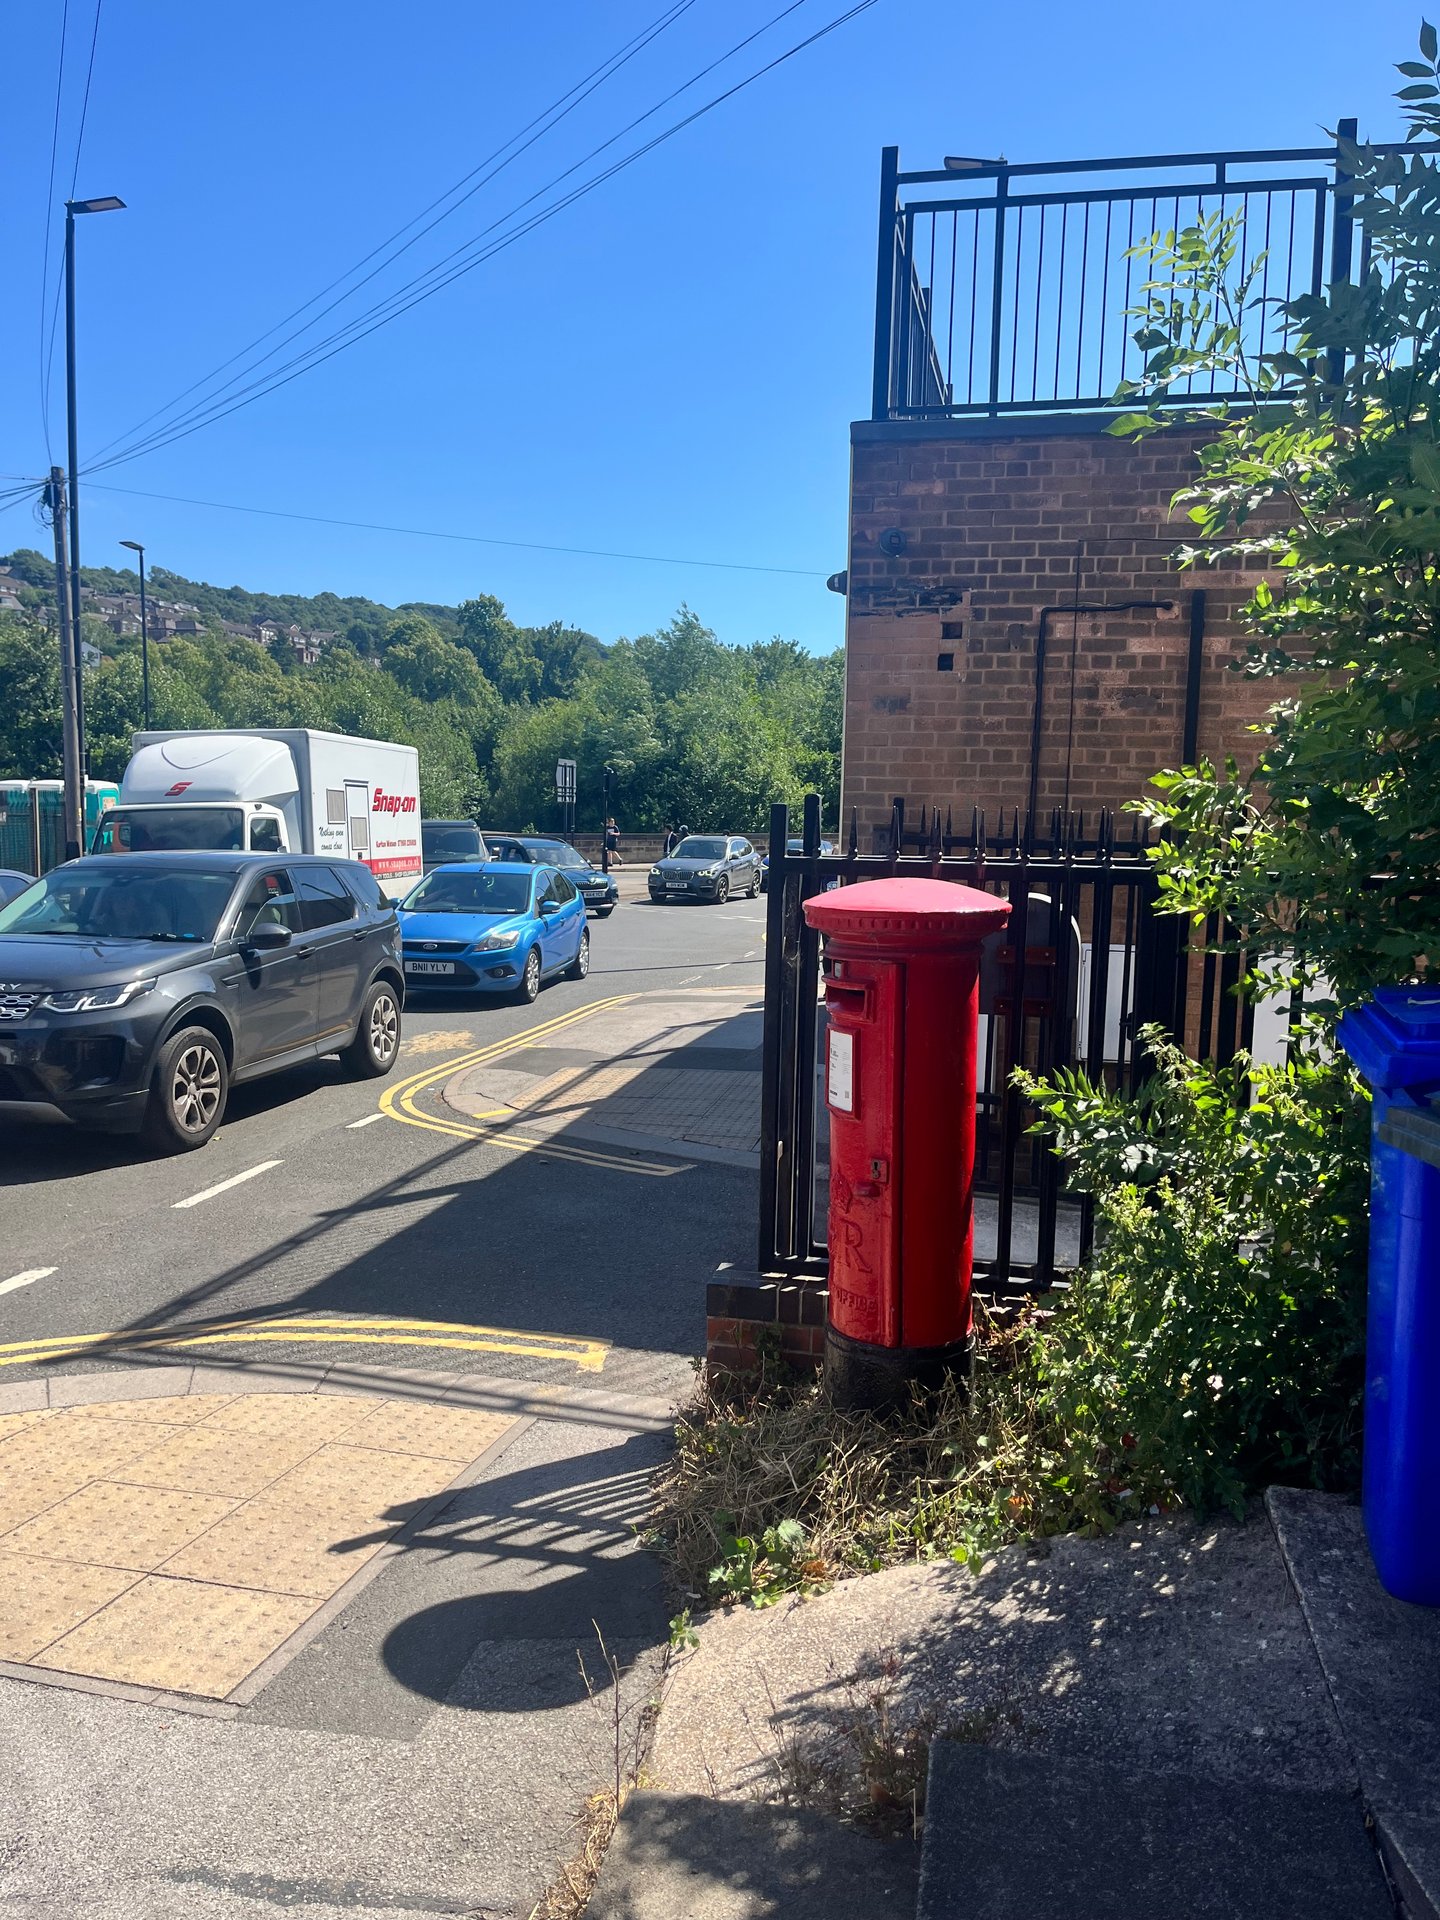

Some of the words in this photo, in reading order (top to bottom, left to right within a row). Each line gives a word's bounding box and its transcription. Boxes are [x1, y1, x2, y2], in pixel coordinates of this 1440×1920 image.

[372, 788, 416, 817] Snap-on
[412, 963, 428, 971] BN11
[430, 964, 447, 972] YLY
